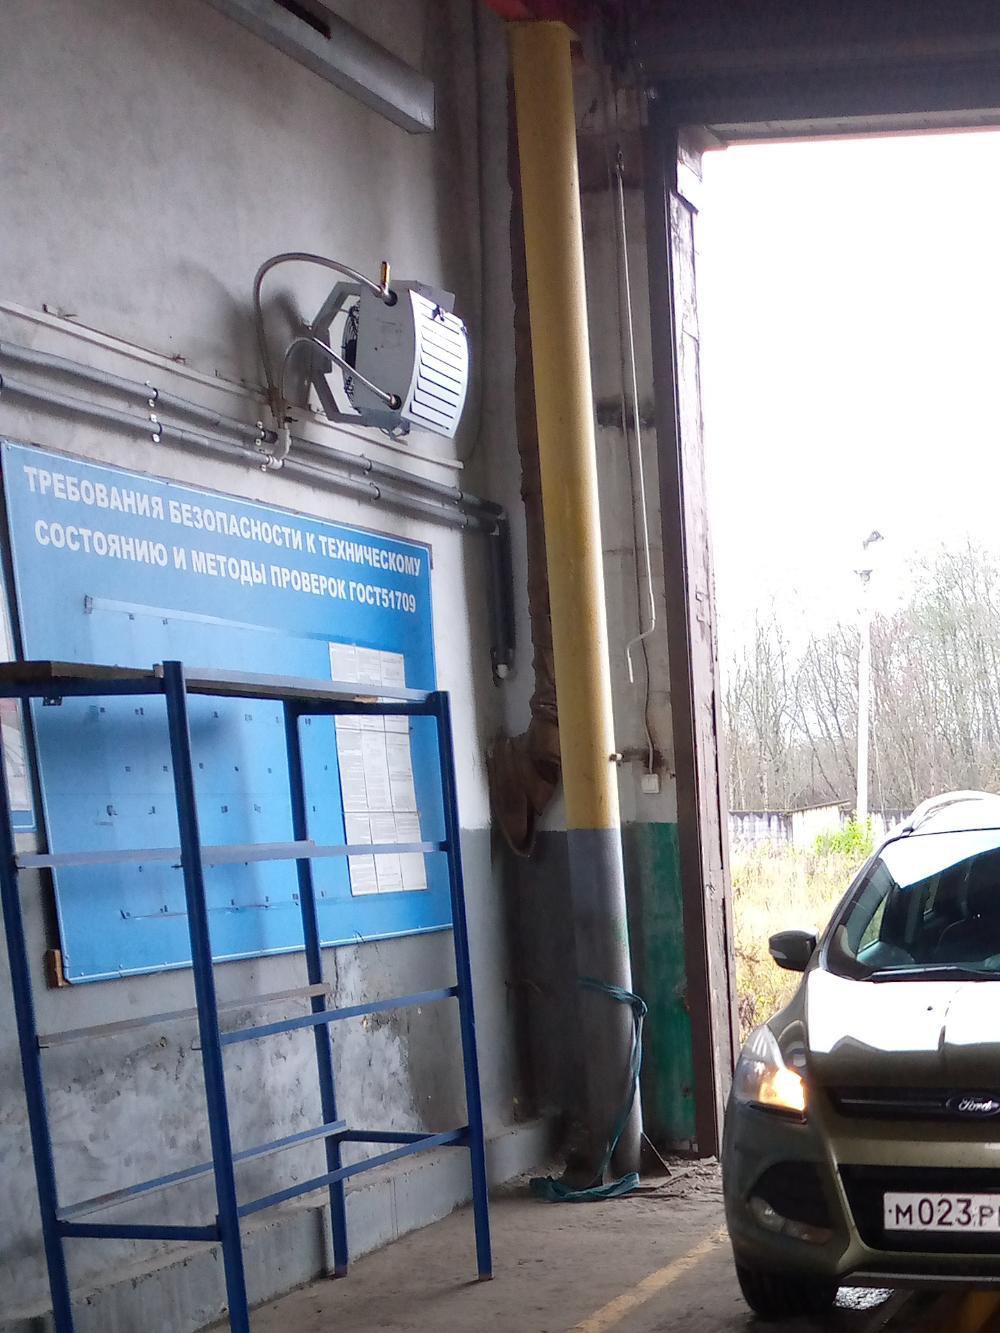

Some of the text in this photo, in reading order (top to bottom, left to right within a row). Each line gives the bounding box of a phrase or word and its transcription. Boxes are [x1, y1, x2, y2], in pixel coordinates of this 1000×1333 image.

[23, 465, 421, 577] ТРЕБОВАНИЯ БЕЗОПАСНОСТИ К ТЕХНИЧЕСКОМУ
[35, 519, 417, 614] СОСТОЯНИЮ И МЕТОДЫ ПРОВЕРОК ГОСТ51709
